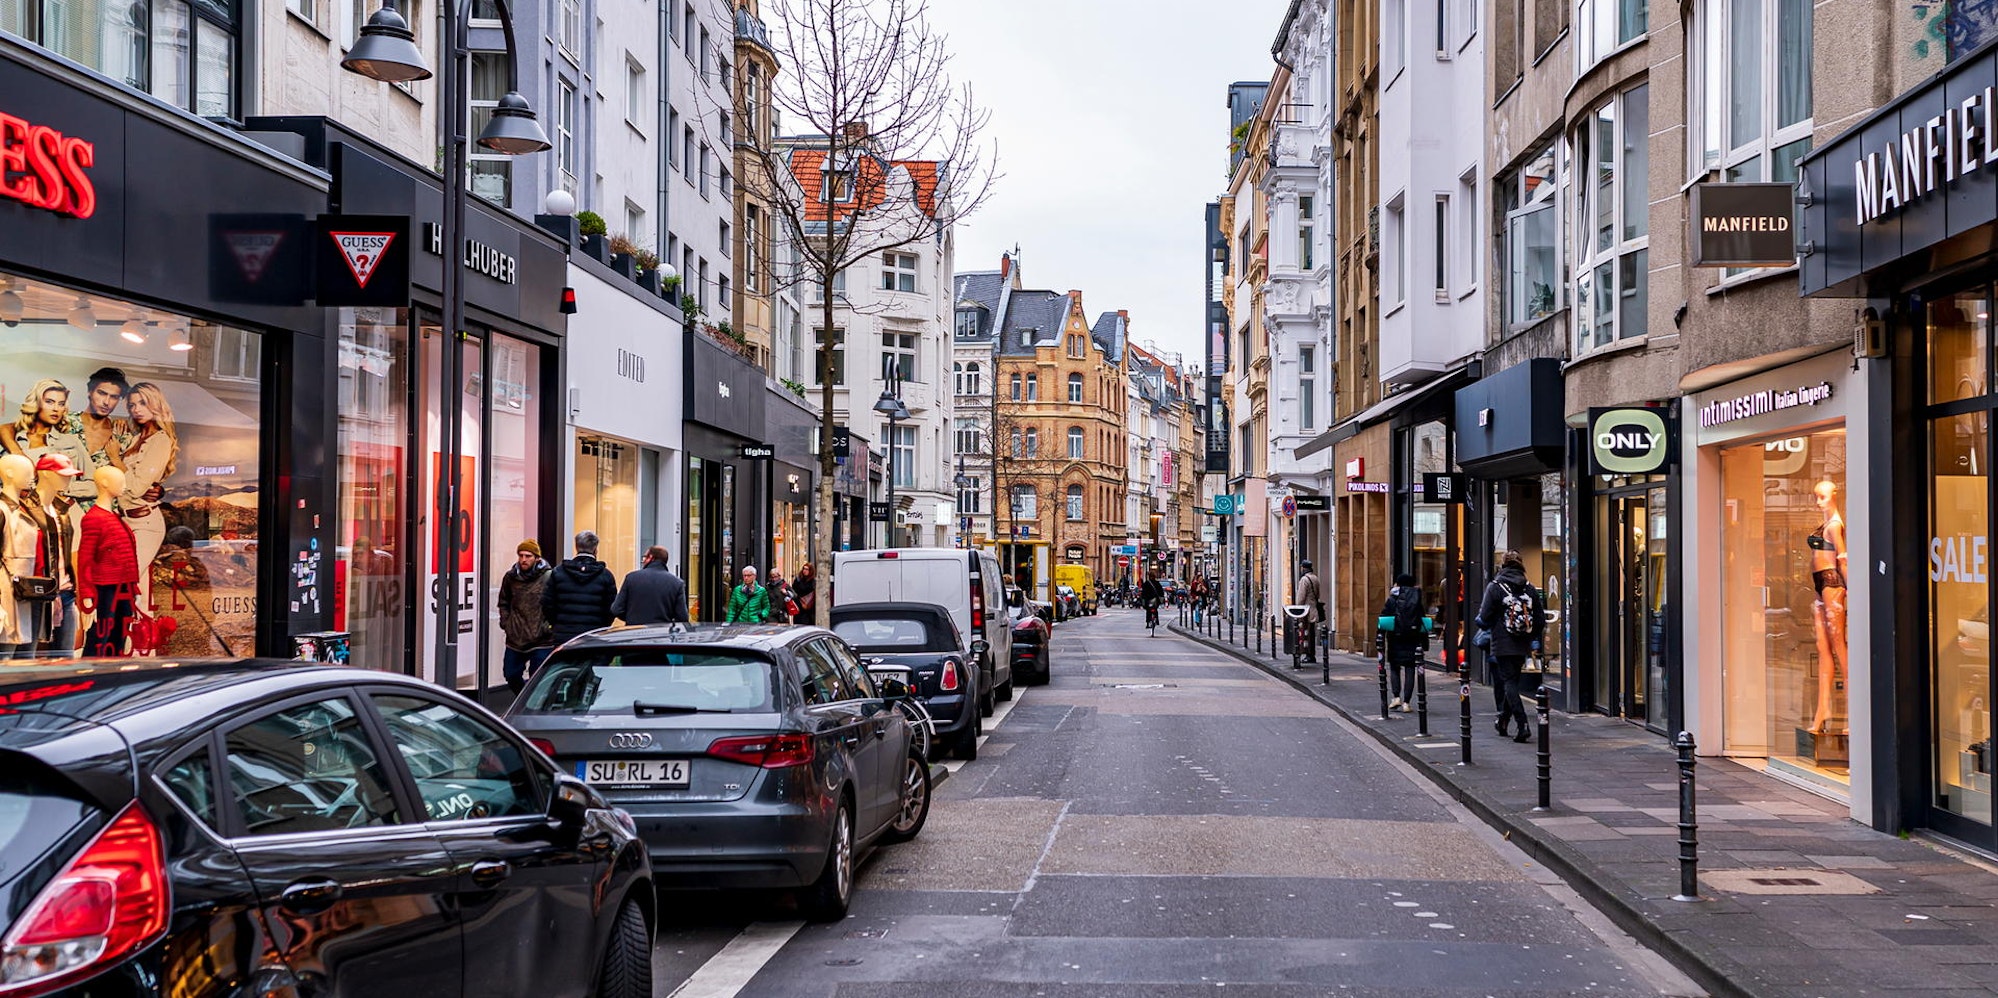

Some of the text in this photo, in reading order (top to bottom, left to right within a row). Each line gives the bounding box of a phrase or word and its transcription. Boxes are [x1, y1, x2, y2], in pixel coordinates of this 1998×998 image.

[1704, 216, 1789, 232] MANFIELD
[341, 236, 385, 248] GUESS
[618, 348, 645, 383] EDITED
[1700, 390, 1774, 428] intimissimi
[1774, 390, 1798, 410] Italian
[1597, 432, 1662, 450] ONLY
[744, 447, 771, 457] tigha
[1348, 483, 1379, 492] PIKOLINOS
[1931, 536, 1986, 583] SALE
[212, 596, 257, 614] GUESS
[590, 763, 683, 781] SU RL 16
